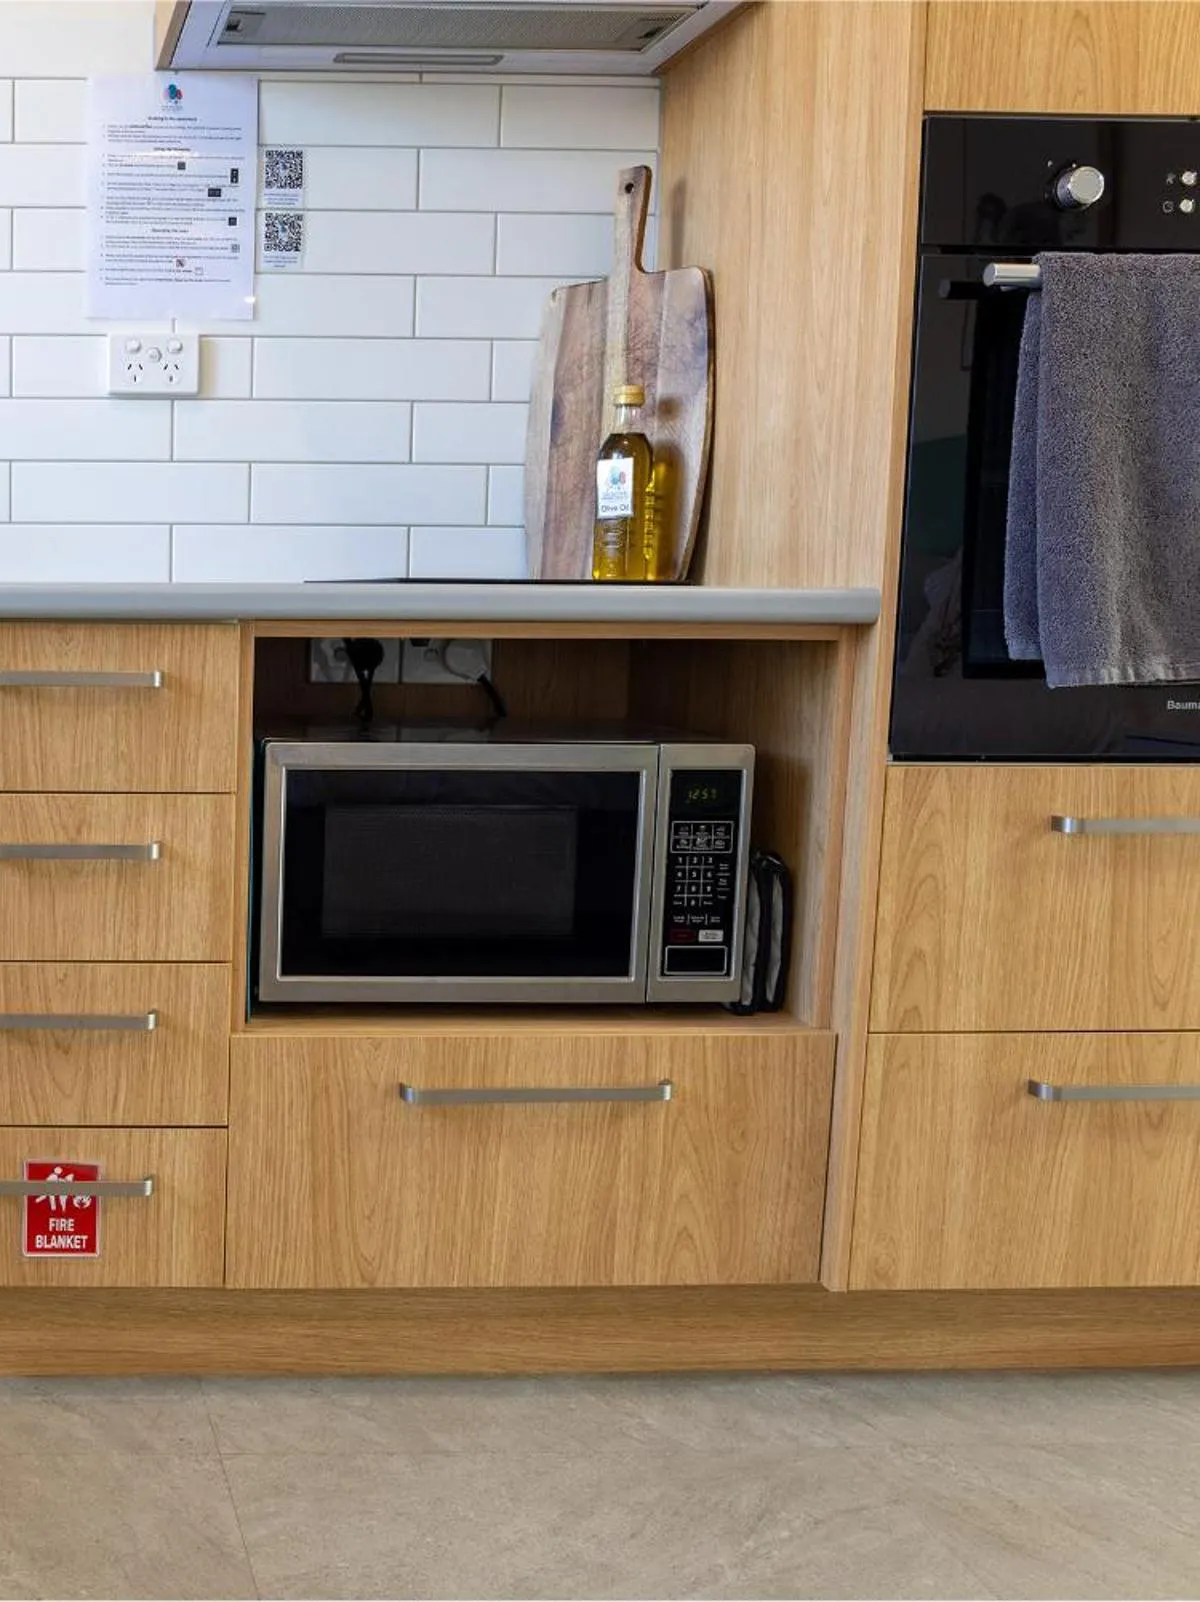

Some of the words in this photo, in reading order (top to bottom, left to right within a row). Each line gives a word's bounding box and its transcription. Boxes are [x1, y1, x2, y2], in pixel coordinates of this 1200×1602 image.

[601, 504, 618, 512] Olive
[48, 1218, 75, 1232] FIRE
[35, 1234, 88, 1249] BLANKET
